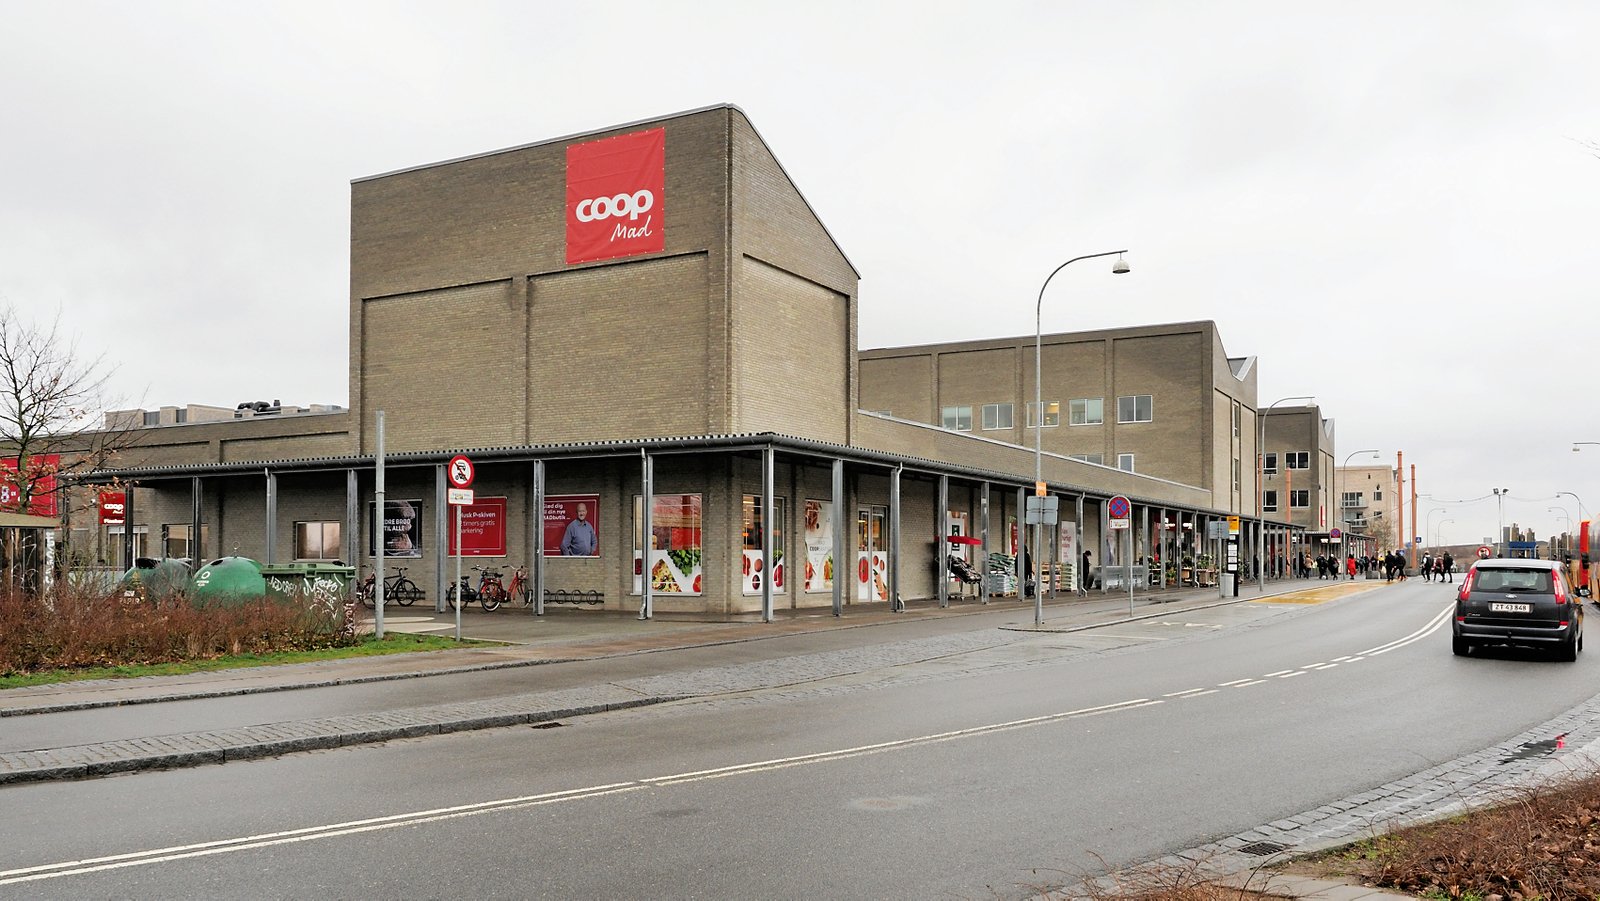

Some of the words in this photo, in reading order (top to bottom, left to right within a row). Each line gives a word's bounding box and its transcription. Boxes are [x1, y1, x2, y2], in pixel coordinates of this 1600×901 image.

[576, 189, 654, 223] coop
[610, 215, 653, 242] Mad
[461, 527, 484, 535] arkering
